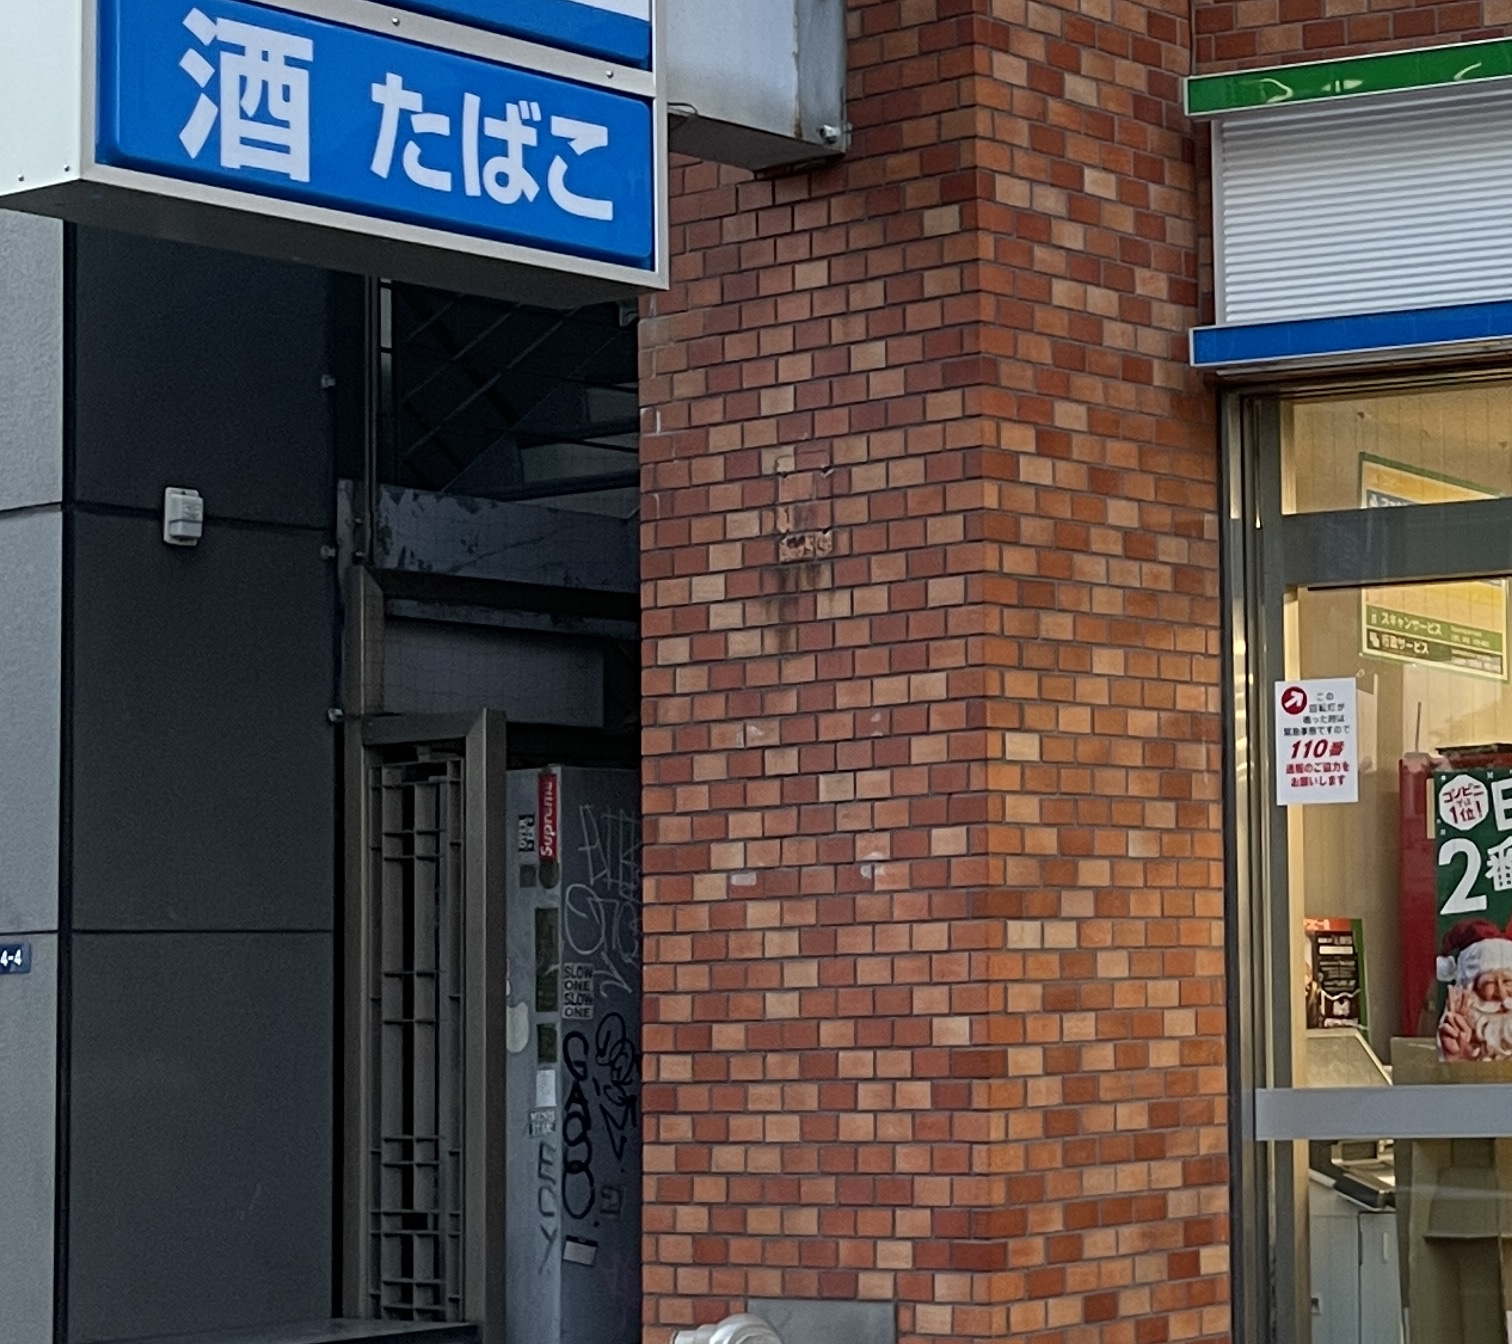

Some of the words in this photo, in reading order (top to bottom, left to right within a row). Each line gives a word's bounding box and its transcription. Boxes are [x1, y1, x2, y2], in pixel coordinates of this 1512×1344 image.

[177, 6, 315, 184] 酒
[369, 71, 616, 224] たばこ
[1291, 738, 1345, 760] 110番
[1442, 782, 1485, 804] コンビニ
[563, 978, 592, 992] ONE
[563, 1006, 592, 1019] ONE
